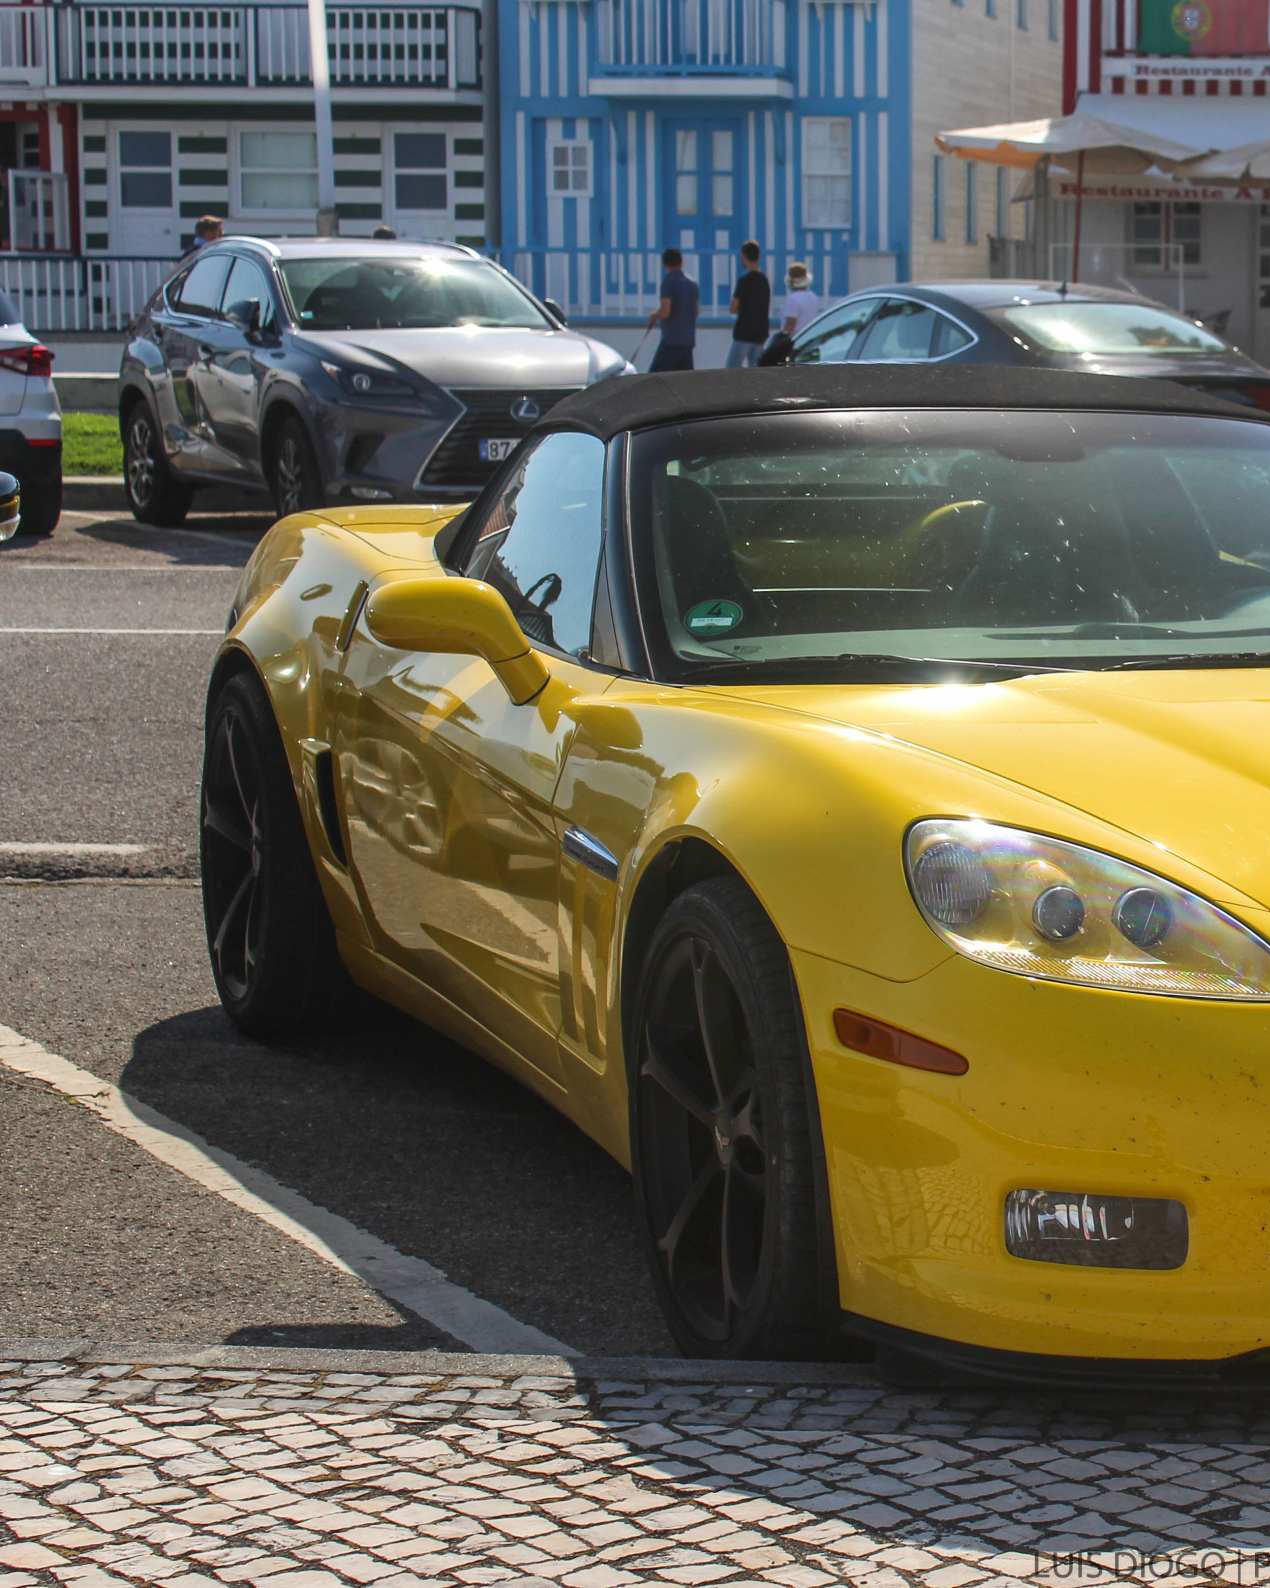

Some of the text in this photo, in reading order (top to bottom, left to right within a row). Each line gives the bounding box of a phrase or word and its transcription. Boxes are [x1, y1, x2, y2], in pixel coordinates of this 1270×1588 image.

[1134, 64, 1253, 77] Restaurante
[1059, 183, 1225, 199] Restaurante
[1235, 186, 1254, 200] A
[706, 602, 723, 617] 4
